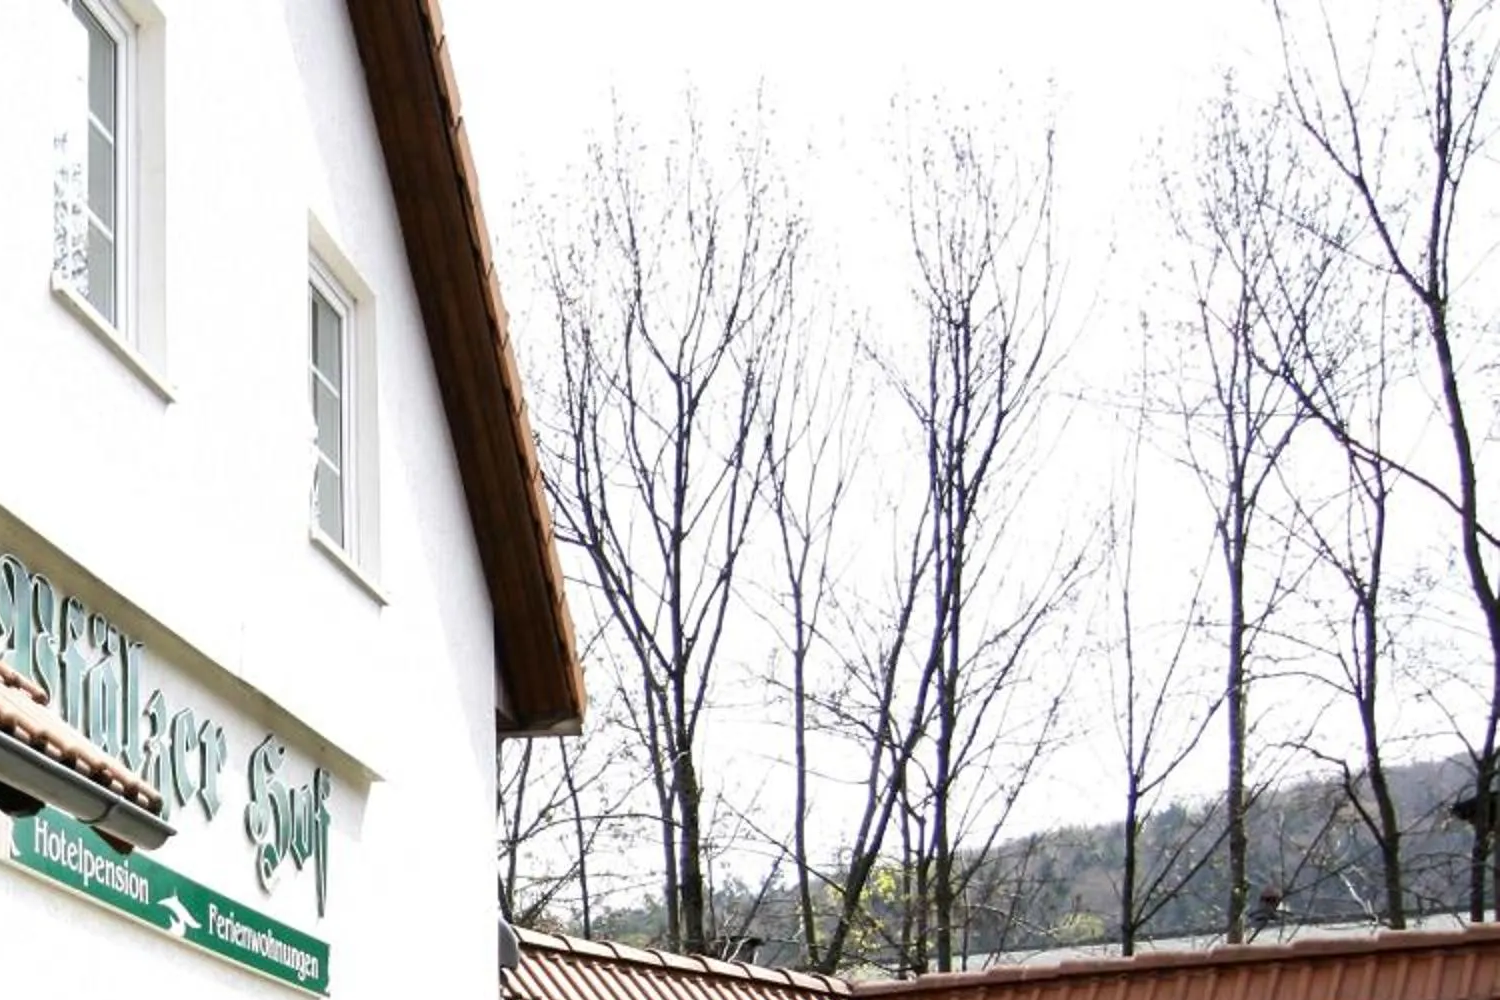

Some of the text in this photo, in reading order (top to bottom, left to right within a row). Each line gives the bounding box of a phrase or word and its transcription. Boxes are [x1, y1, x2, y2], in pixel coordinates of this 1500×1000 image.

[33, 813, 320, 981] Hotelpension Ferienwohnungen
[244, 733, 331, 918] Hof
